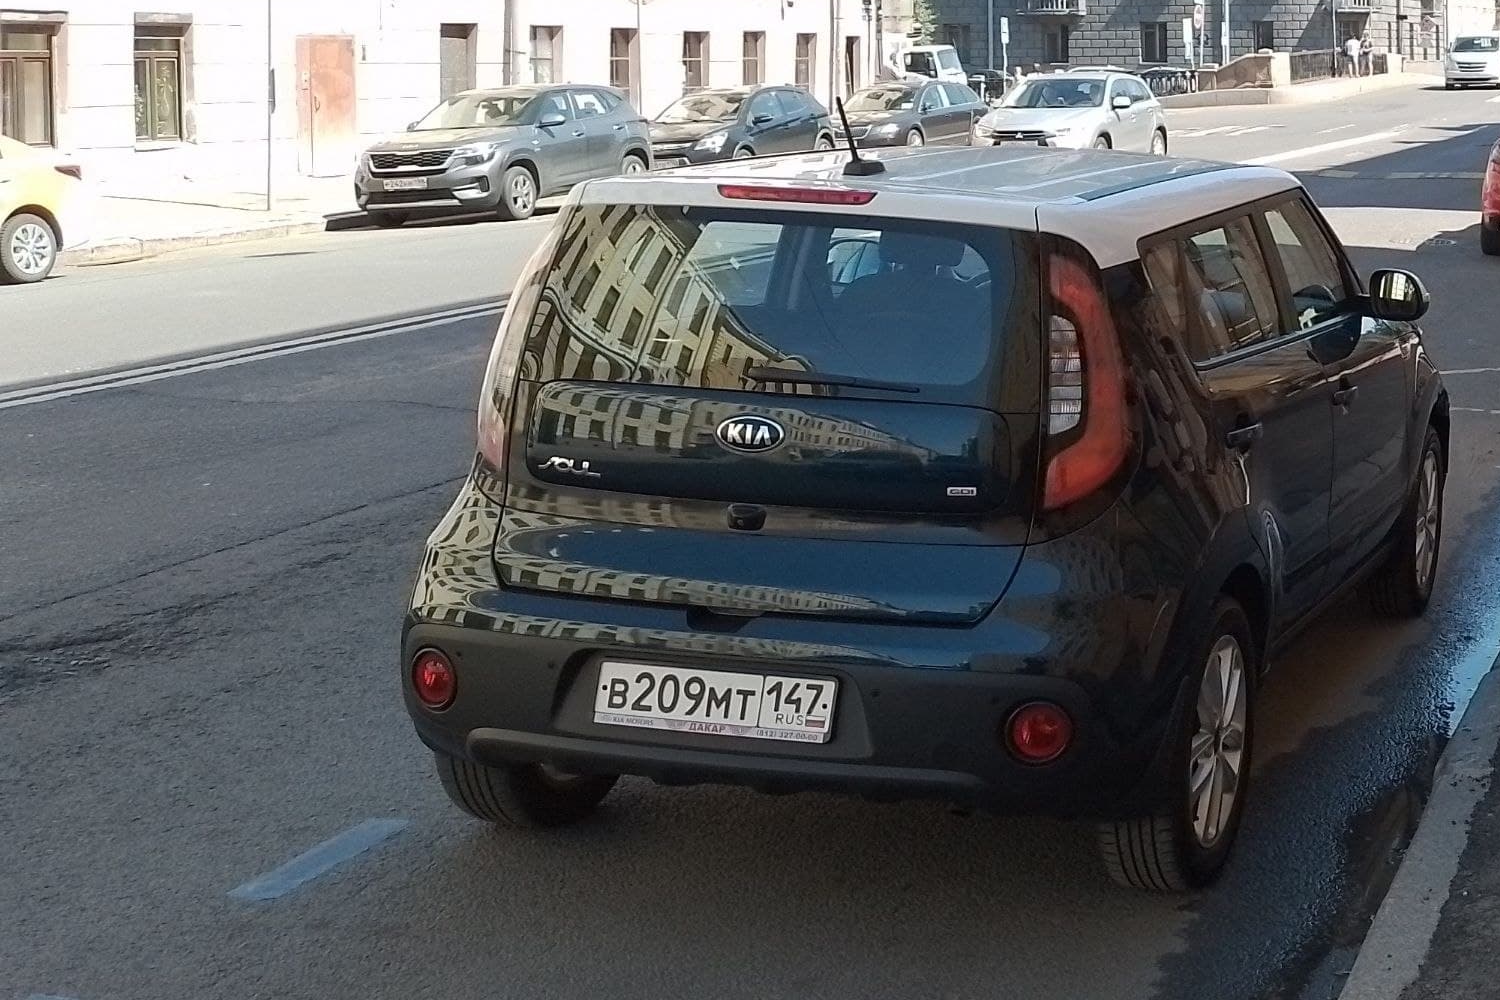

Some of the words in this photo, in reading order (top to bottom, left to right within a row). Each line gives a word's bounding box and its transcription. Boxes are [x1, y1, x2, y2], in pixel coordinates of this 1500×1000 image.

[726, 422, 772, 445] KIA
[607, 672, 756, 721] В209МТ
[766, 681, 825, 716] 147
[688, 722, 726, 733] ДАКАР
[775, 713, 804, 726] RUS
